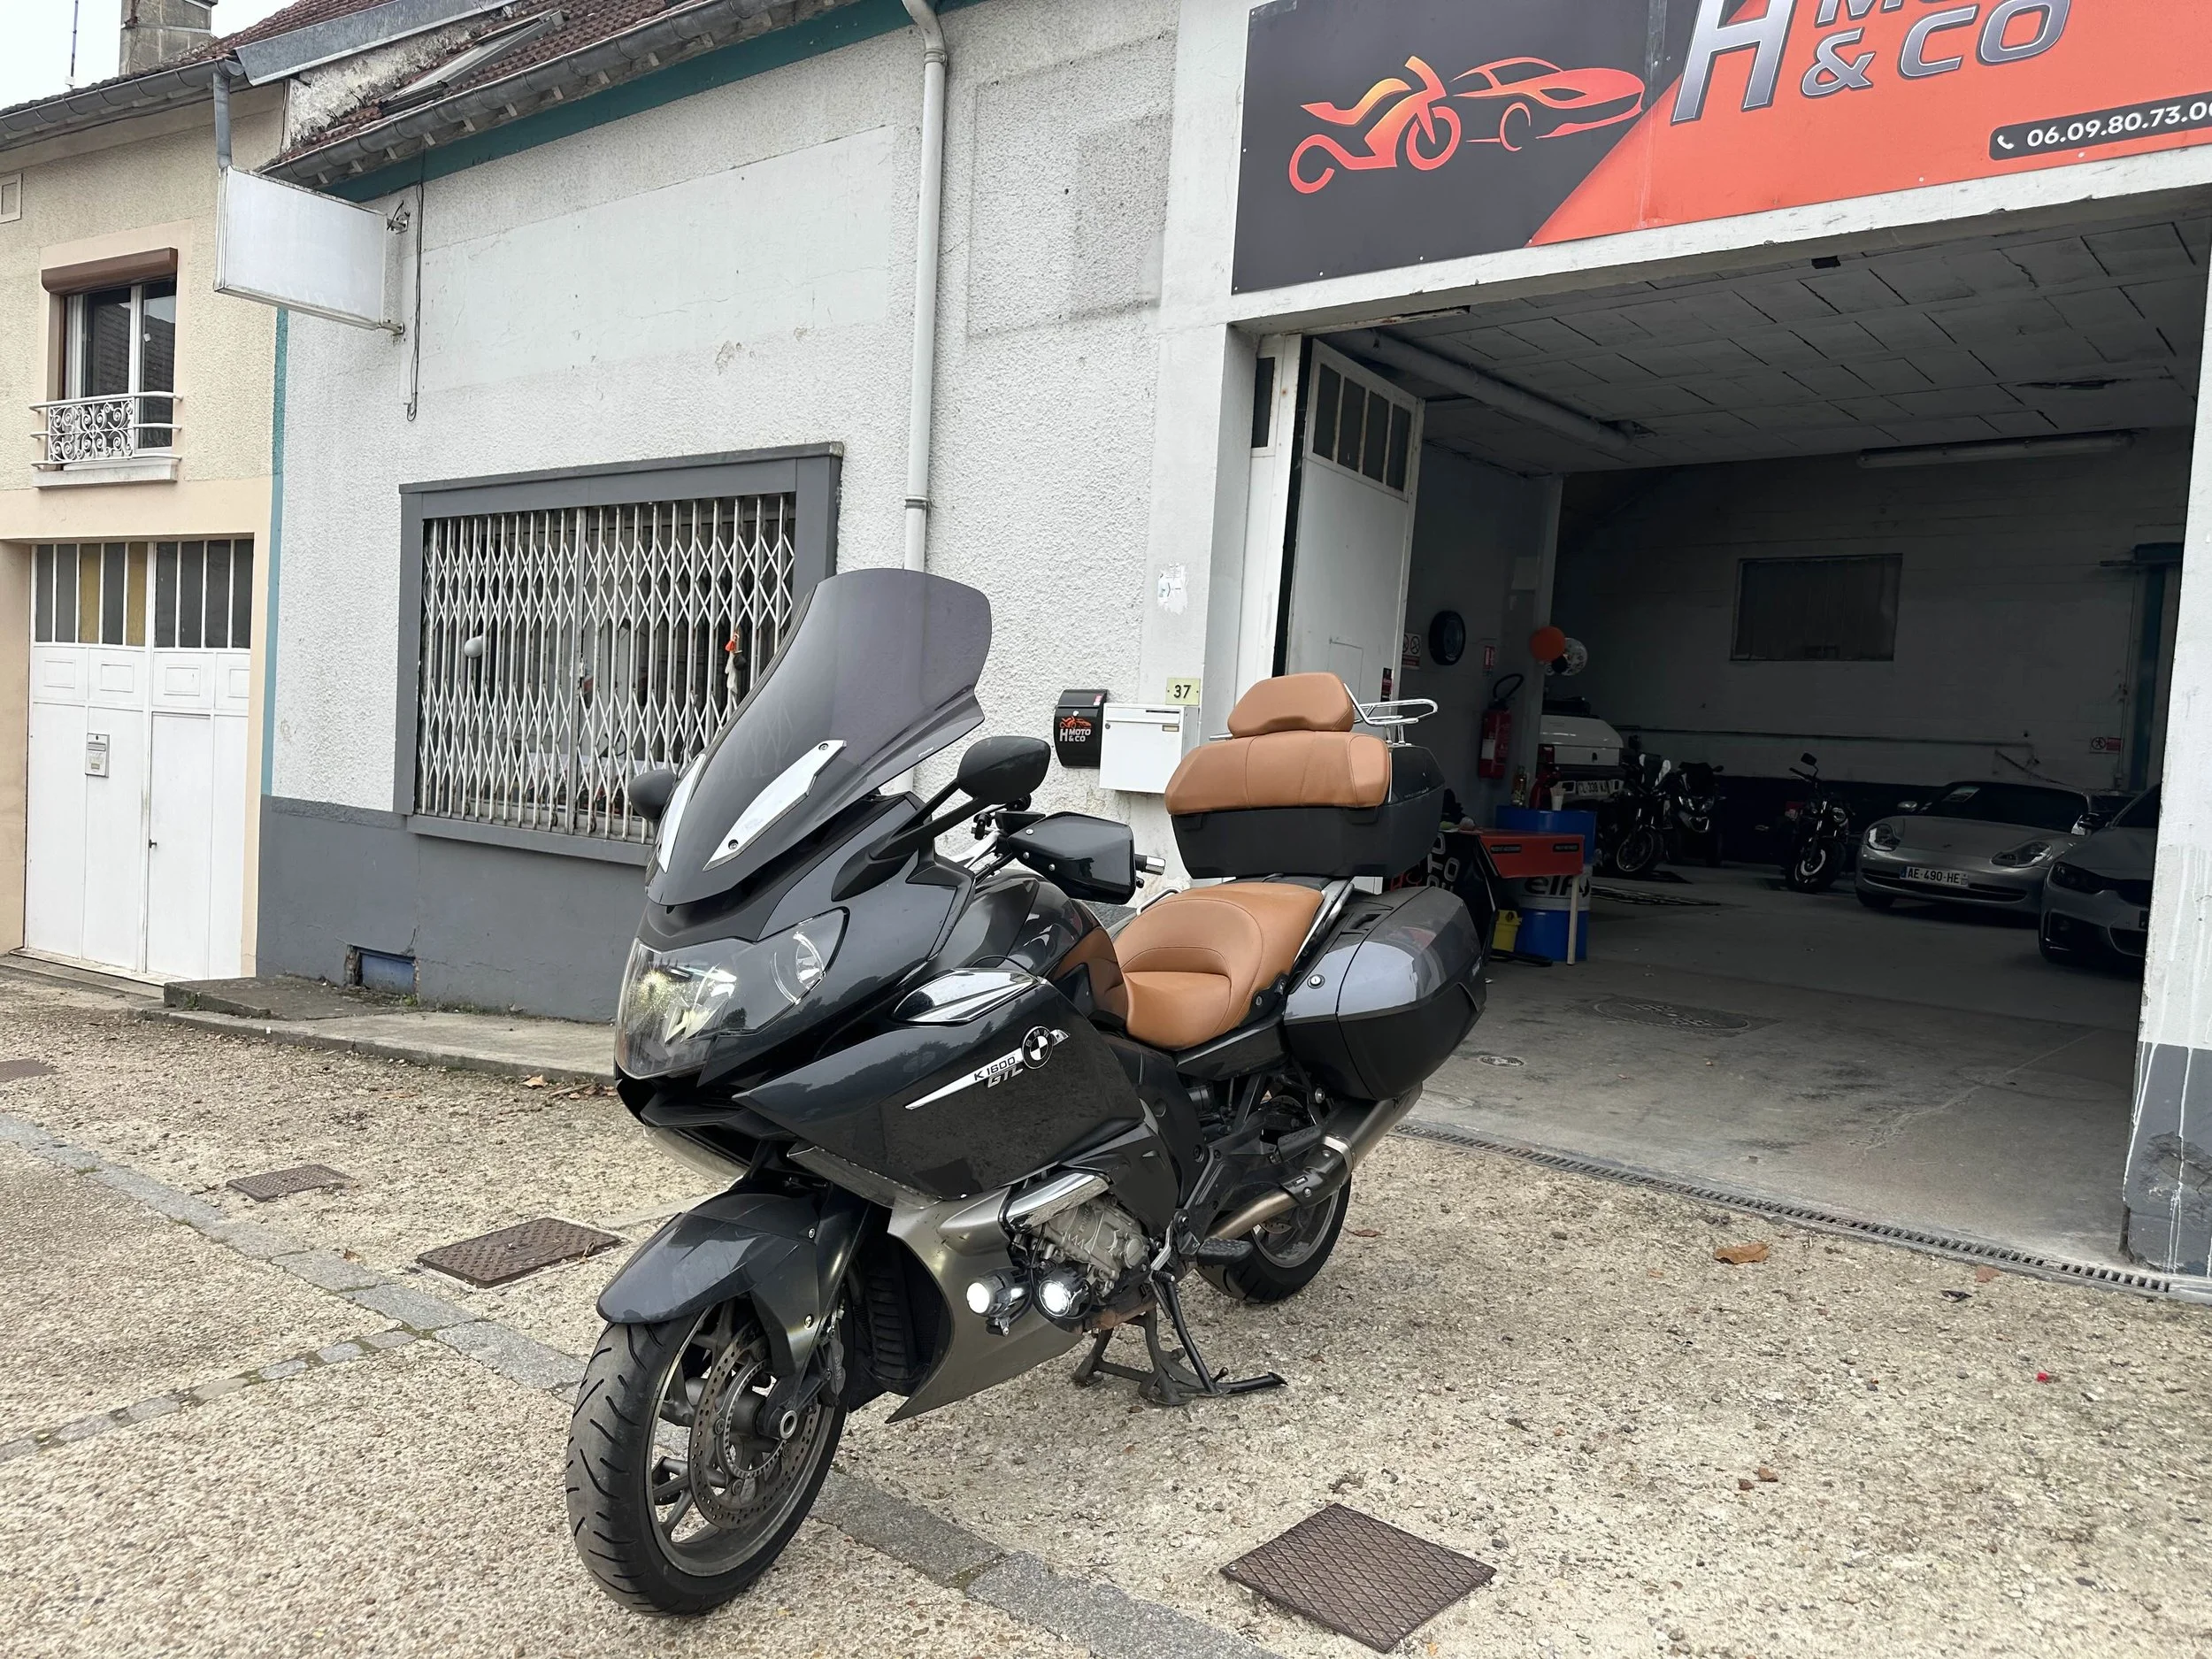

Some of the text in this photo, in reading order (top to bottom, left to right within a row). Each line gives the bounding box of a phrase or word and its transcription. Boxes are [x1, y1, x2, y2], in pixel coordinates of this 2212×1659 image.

[1800, 0, 2072, 97] & CO
[2026, 101, 2212, 147] 06.09.80.73.0
[1173, 684, 1191, 698] 37
[1059, 728, 1068, 741] H
[1907, 868, 1961, 884] AE-490-HE
[1025, 1029, 1050, 1048] BMW
[973, 1055, 1017, 1081] K 1600
[987, 1067, 1024, 1088] GTL
